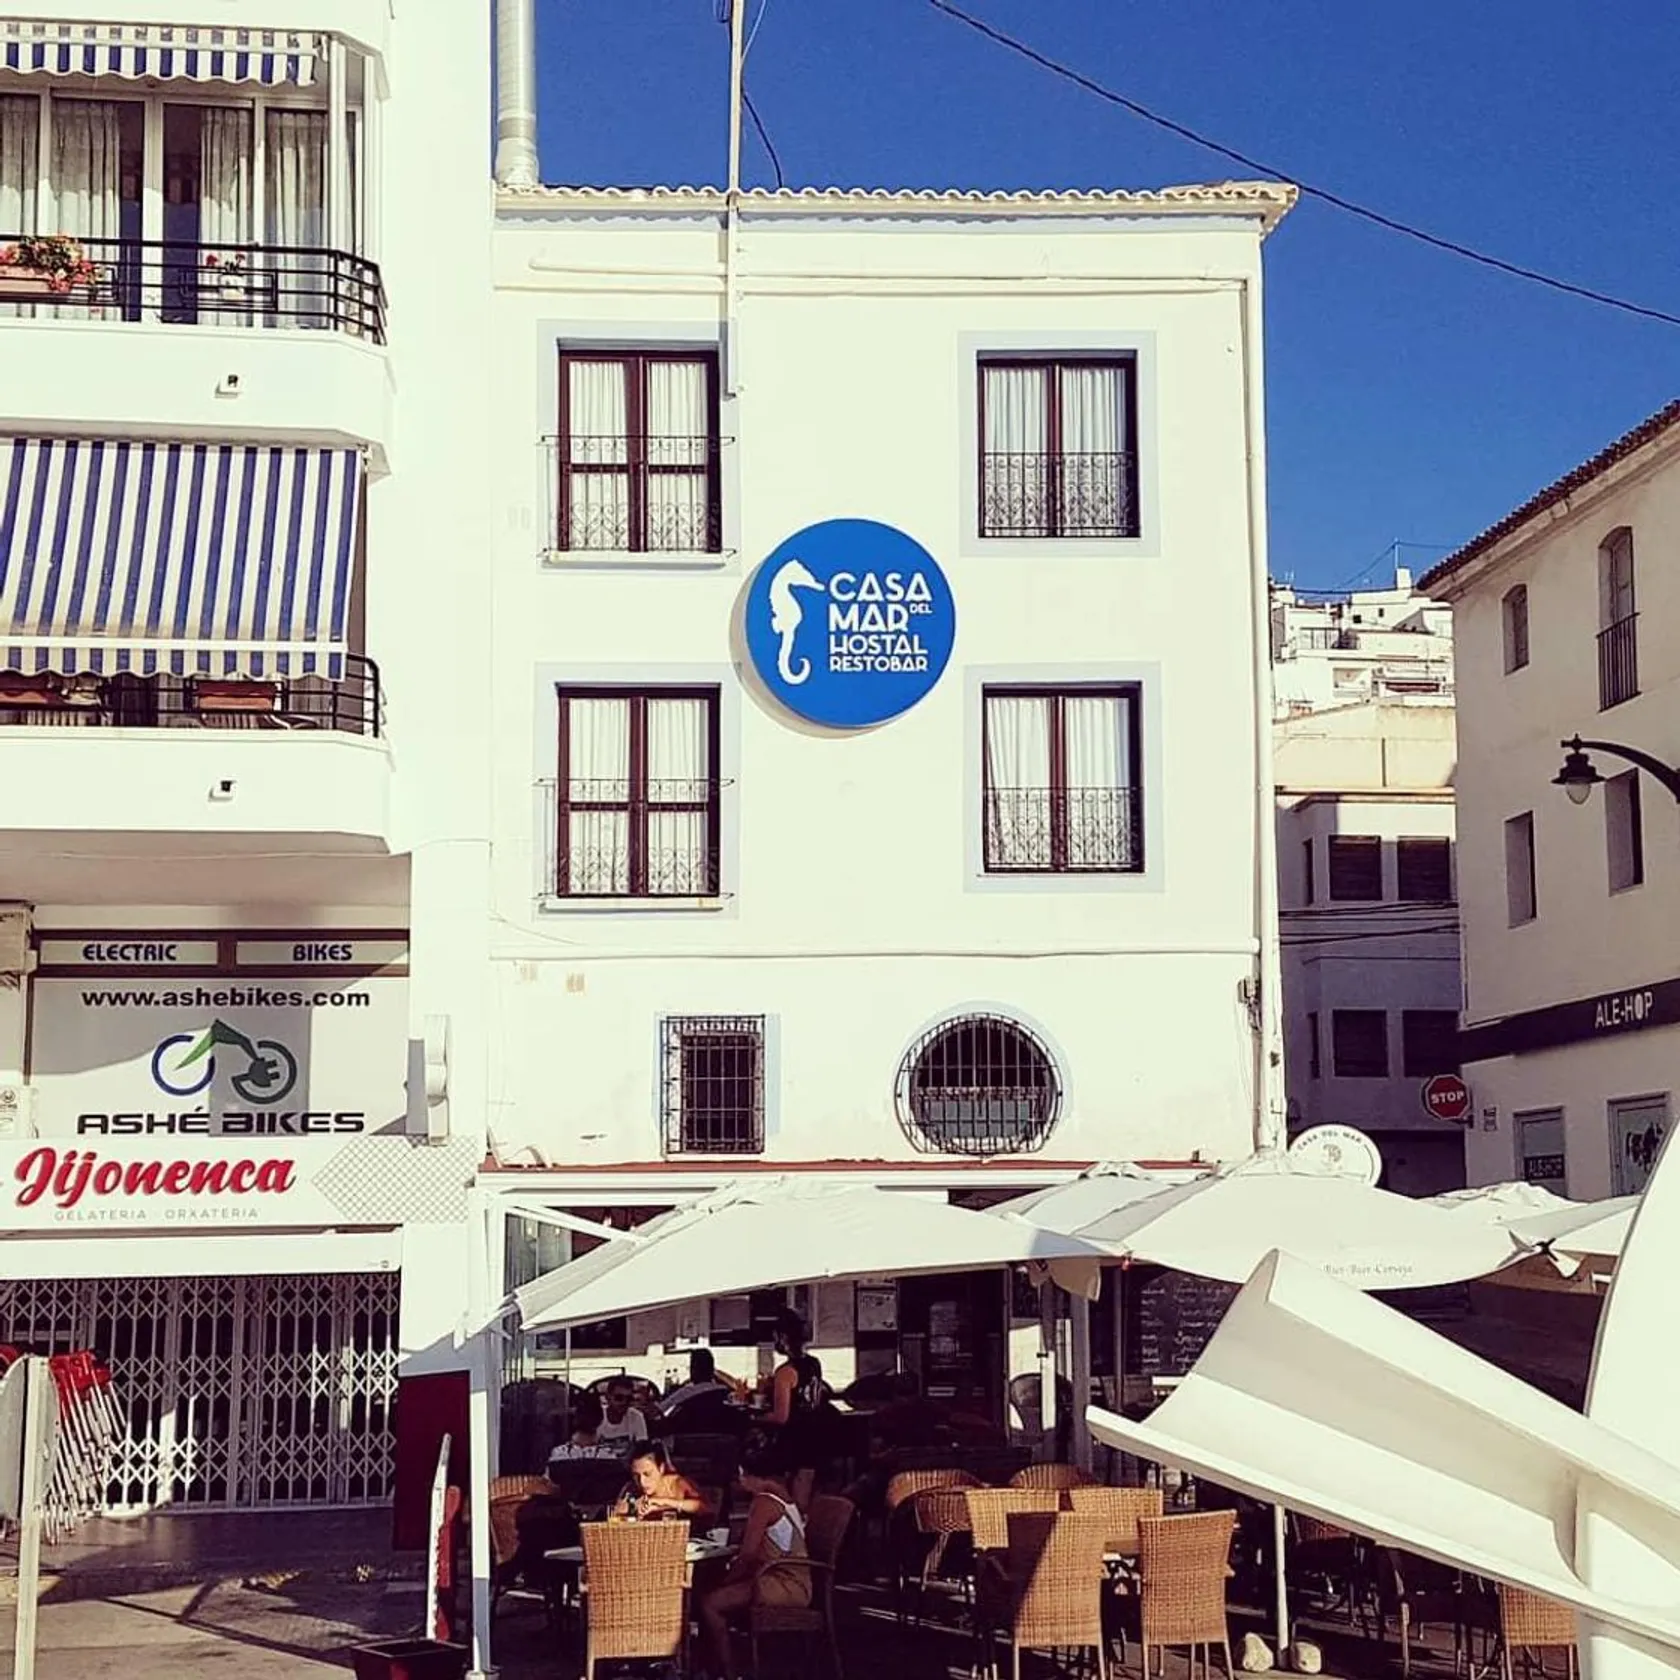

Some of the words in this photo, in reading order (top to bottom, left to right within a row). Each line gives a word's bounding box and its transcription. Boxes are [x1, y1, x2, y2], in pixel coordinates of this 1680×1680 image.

[829, 572, 932, 601] CASA
[829, 603, 908, 632] MAR
[909, 603, 932, 614] DEL
[829, 634, 928, 655] HOSTAL
[829, 656, 928, 672] RESTOBAR
[83, 944, 177, 962] ELECTRIC
[293, 944, 353, 962] BIKES
[82, 988, 370, 1007] www.ashebikes.com
[1594, 991, 1654, 1029] ALE-HOP
[1431, 1091, 1464, 1104] STOP
[77, 1106, 210, 1134] ASHÉ
[222, 1112, 365, 1134] BIKES
[14, 1147, 296, 1209] Jijonenca
[54, 1210, 147, 1221] GELATERIA
[165, 1207, 259, 1219] ORXATERIA
